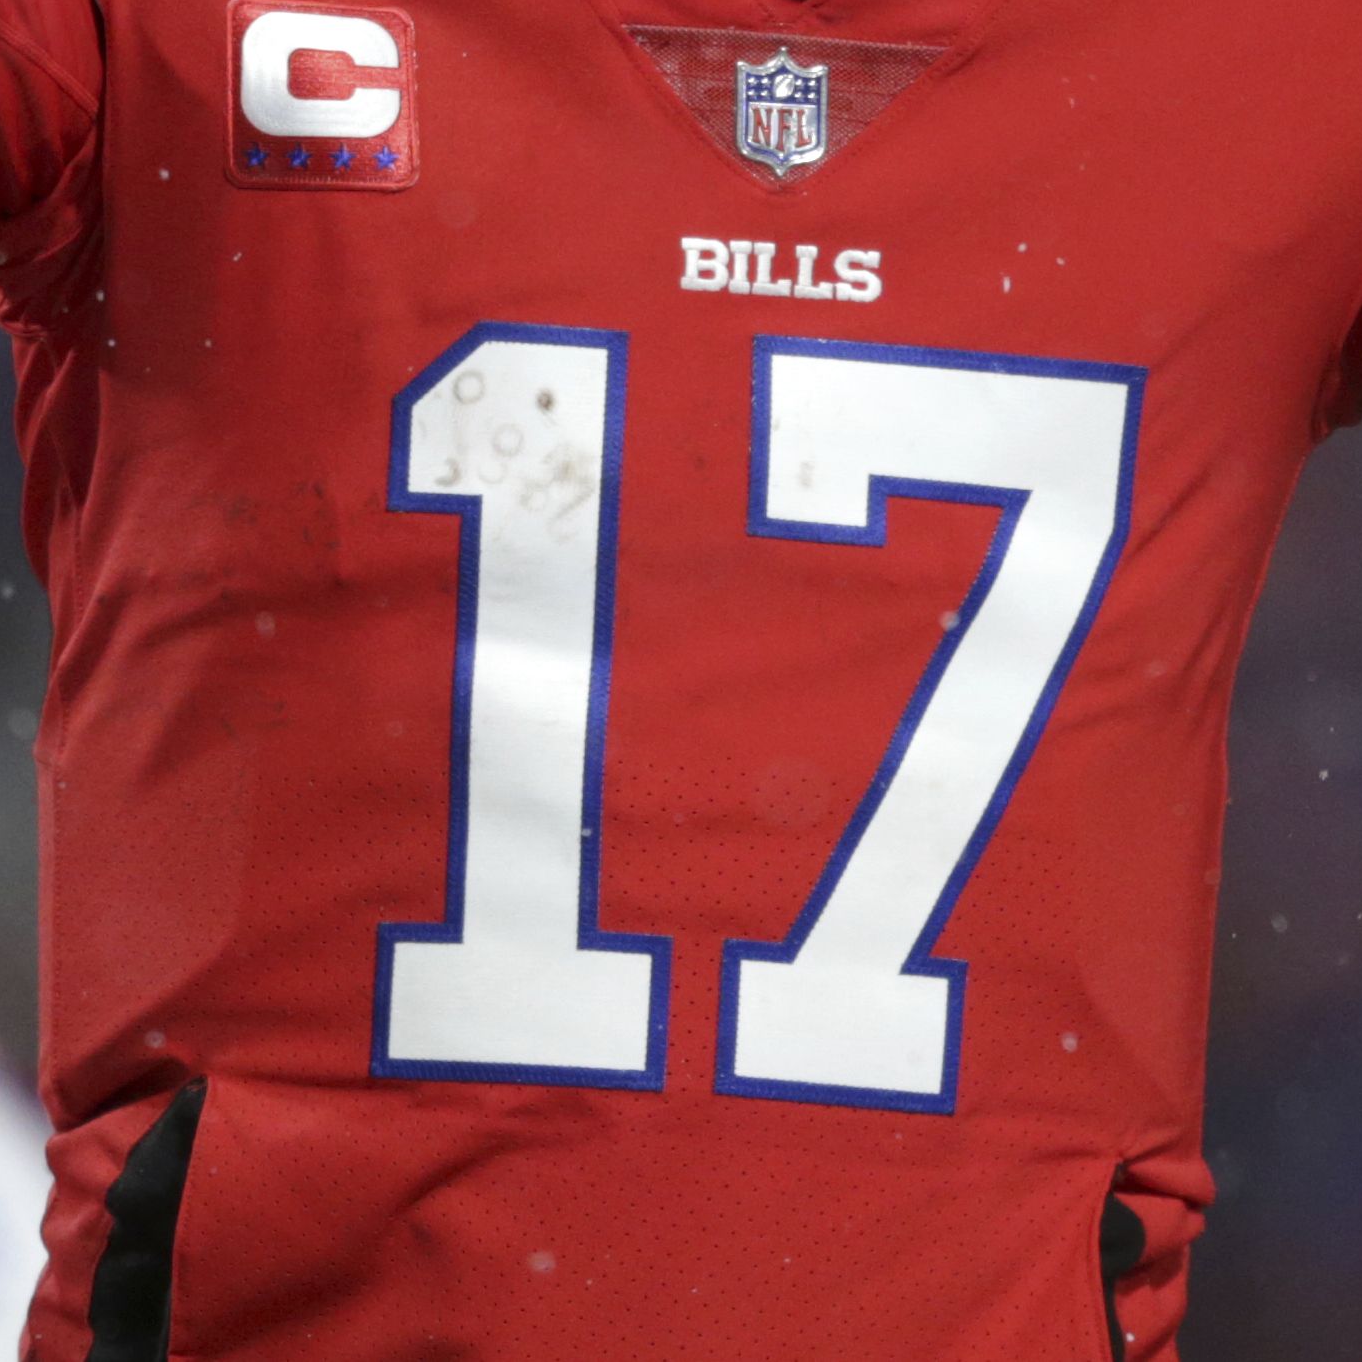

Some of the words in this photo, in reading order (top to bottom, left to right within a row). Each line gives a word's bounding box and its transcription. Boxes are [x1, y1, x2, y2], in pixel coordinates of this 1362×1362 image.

[240, 11, 402, 139] C
[751, 107, 813, 153] NFL
[680, 237, 883, 303] BILLS
[371, 321, 1148, 1115] 17
